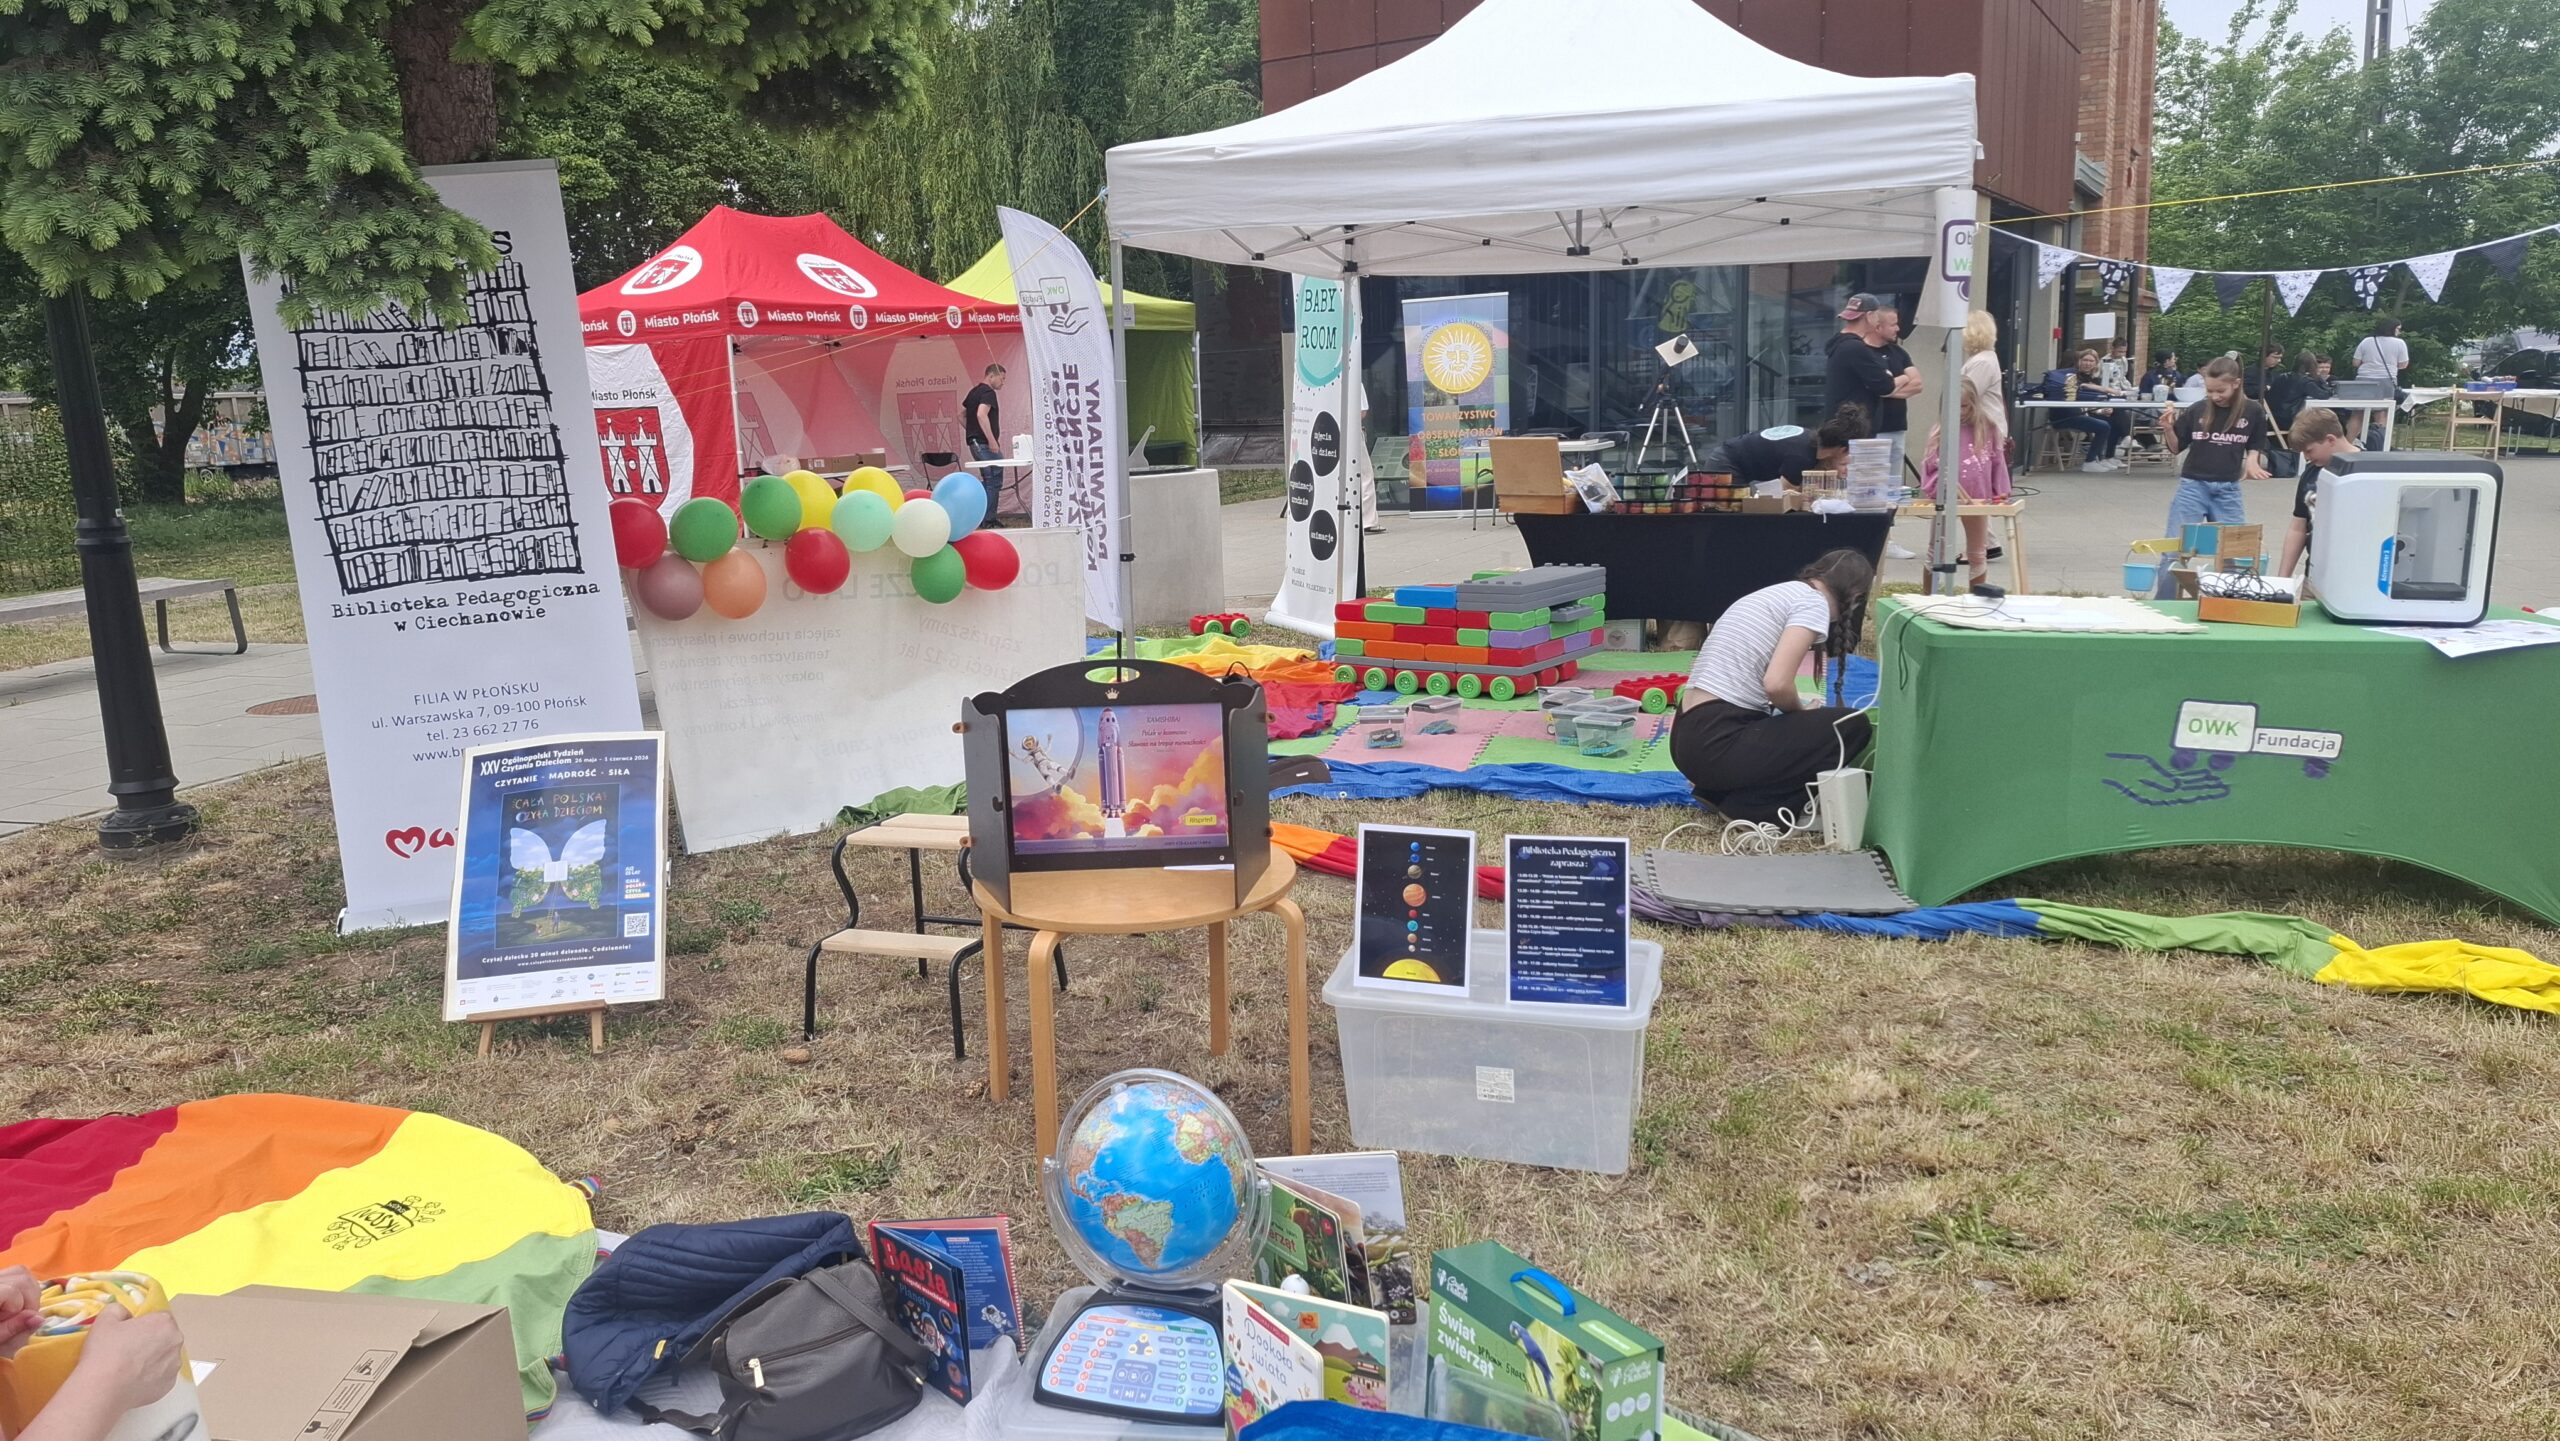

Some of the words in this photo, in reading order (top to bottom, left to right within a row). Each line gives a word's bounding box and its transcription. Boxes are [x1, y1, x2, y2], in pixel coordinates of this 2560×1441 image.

[1304, 288, 1337, 312] BABY
[581, 319, 608, 332] łońsk
[644, 315, 679, 328] Miasto
[683, 310, 719, 324] Płońsk
[767, 309, 803, 322] Miasto
[806, 310, 841, 322] Płońsk
[875, 312, 906, 323] Miasto
[909, 312, 938, 323] Płońsk
[968, 313, 996, 323] Miasto
[1301, 325, 1337, 350] ROOM
[622, 388, 657, 400] Płońsk
[1422, 409, 1497, 421] TOWARZYSTWO
[1417, 425, 1504, 440] OBSERWATORÓW
[2211, 432, 2249, 443] CANYON
[331, 597, 449, 619] Biblioteka
[456, 581, 601, 608] Pedagogiczna
[394, 620, 407, 633] w
[415, 606, 546, 631] Ciechanowie
[413, 685, 450, 706] FILIA
[454, 687, 469, 702] W
[473, 681, 541, 702] PŁOŃSKU
[372, 716, 388, 730] ul.
[391, 707, 474, 728] Warszawska
[477, 705, 490, 720] 7,
[493, 699, 541, 717] 09-100
[544, 694, 588, 710] Płońsk
[426, 727, 449, 743] tel.
[453, 725, 469, 740] 23
[473, 722, 499, 737] 662
[502, 720, 518, 735] 27
[522, 717, 540, 732] 76
[2188, 717, 2241, 737] OWK
[2256, 732, 2336, 752] Fundacja
[480, 758, 500, 776] XXV
[501, 752, 551, 767] Ogólnopolski
[553, 748, 584, 760] Tydzień
[501, 761, 534, 773] Czytania
[535, 757, 572, 768] Dzieciom
[495, 774, 538, 788] CZYTANIE
[549, 768, 597, 780] MĄDROŚĆ
[608, 768, 630, 776] SIŁA
[1522, 846, 1561, 855] Biblioteka
[1562, 847, 1616, 858] Pedagogiczna
[1550, 860, 1584, 868] zaprasza
[881, 1237, 949, 1298] Basia
[899, 1282, 931, 1312] Planety
[1439, 1302, 1476, 1345] Świat
[1244, 1317, 1293, 1373] Dookoła
[1438, 1328, 1494, 1380] zwierząt
[1252, 1345, 1288, 1386] świata
